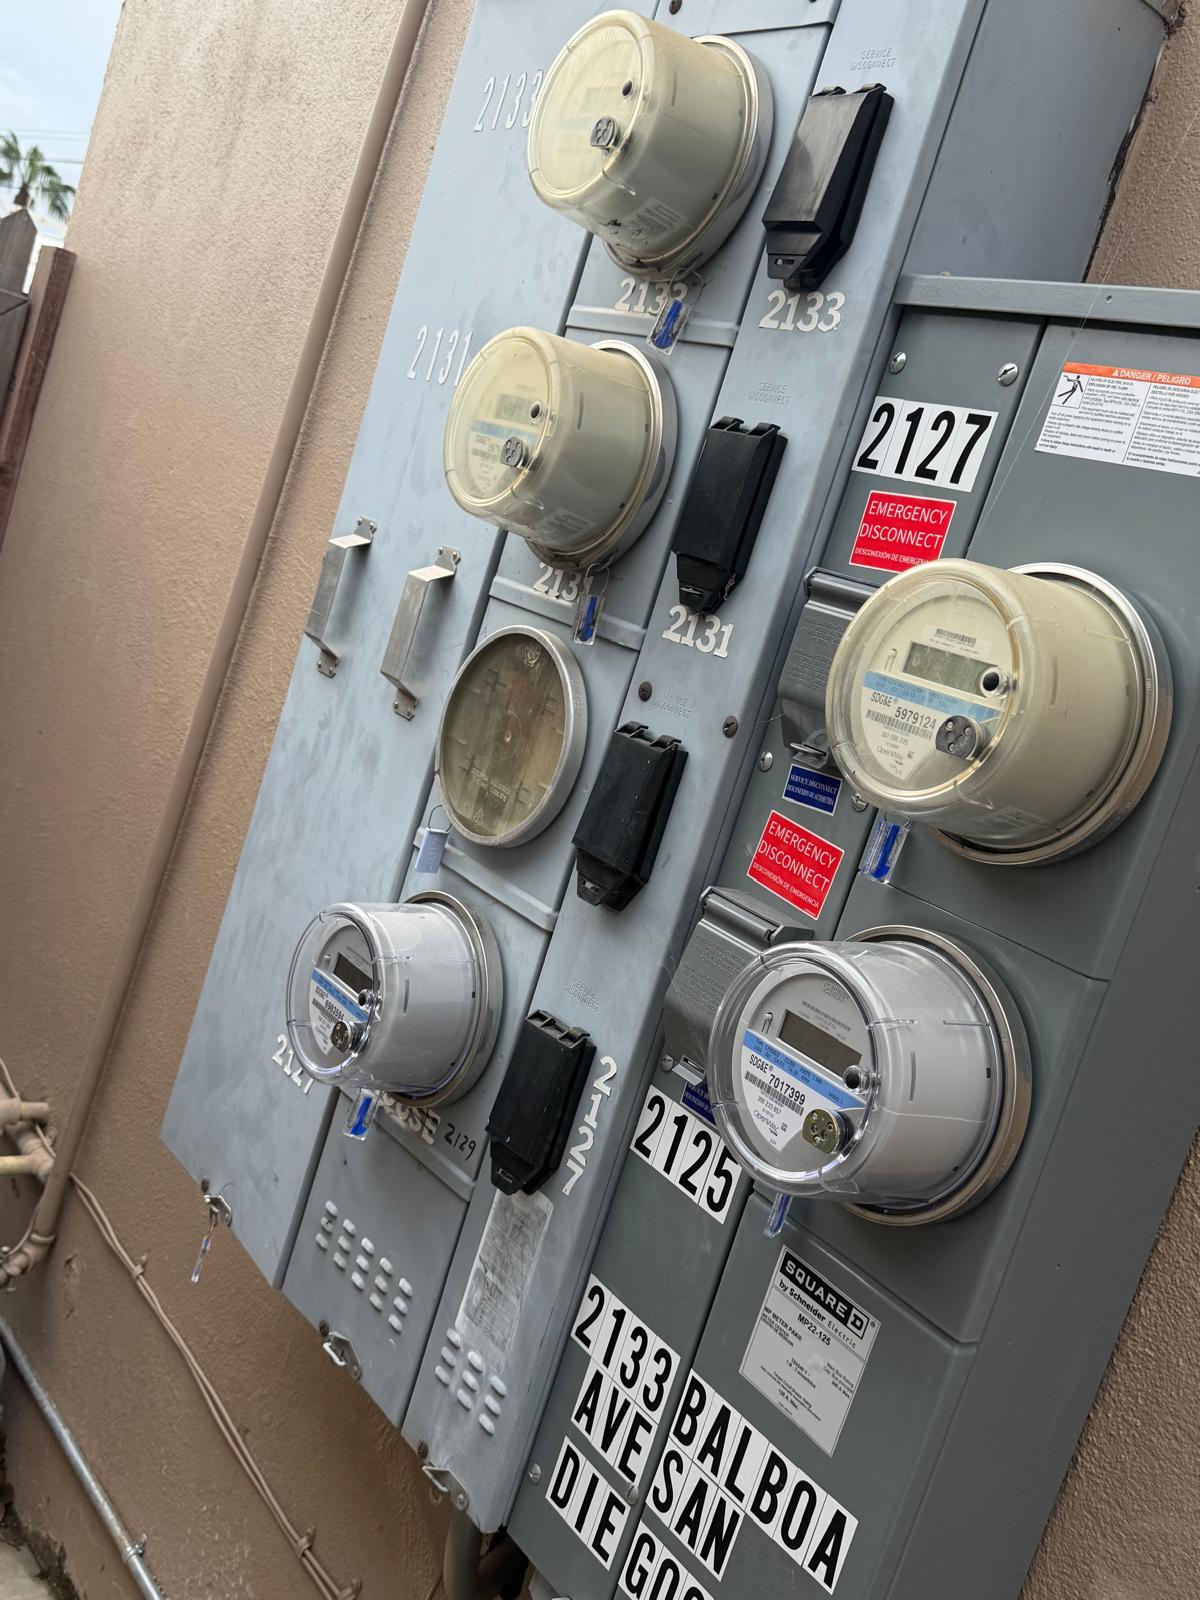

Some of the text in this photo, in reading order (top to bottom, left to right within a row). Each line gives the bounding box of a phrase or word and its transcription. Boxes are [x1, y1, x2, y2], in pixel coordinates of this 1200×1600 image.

[758, 290, 846, 332] 2133
[407, 325, 473, 387] 2131
[1120, 370, 1151, 381] DANGER
[1157, 374, 1191, 385] PELIGRO
[857, 402, 992, 485] 2127
[859, 523, 943, 549] DISCONNECT
[868, 500, 948, 525] EMERGENCY
[891, 553, 898, 562] DE
[662, 605, 734, 658] 2131
[895, 706, 937, 730] 5979124
[758, 840, 830, 892] DISCONNECT
[768, 820, 836, 868] EMERGENCY
[789, 887, 819, 909] EMERGENCIA
[769, 1074, 806, 1105] 7017399
[444, 1122, 476, 1162] 2129
[562, 1055, 617, 1196] 2127
[634, 1095, 739, 1213] 2125
[785, 1259, 848, 1319] SQUARE
[779, 1280, 857, 1350] by Schneider Electric
[798, 1313, 831, 1346] MP22-125
[574, 1284, 848, 1588] 2133 BALBOA
[574, 1369, 741, 1576] AVE SAN
[550, 1444, 627, 1564] DIE
